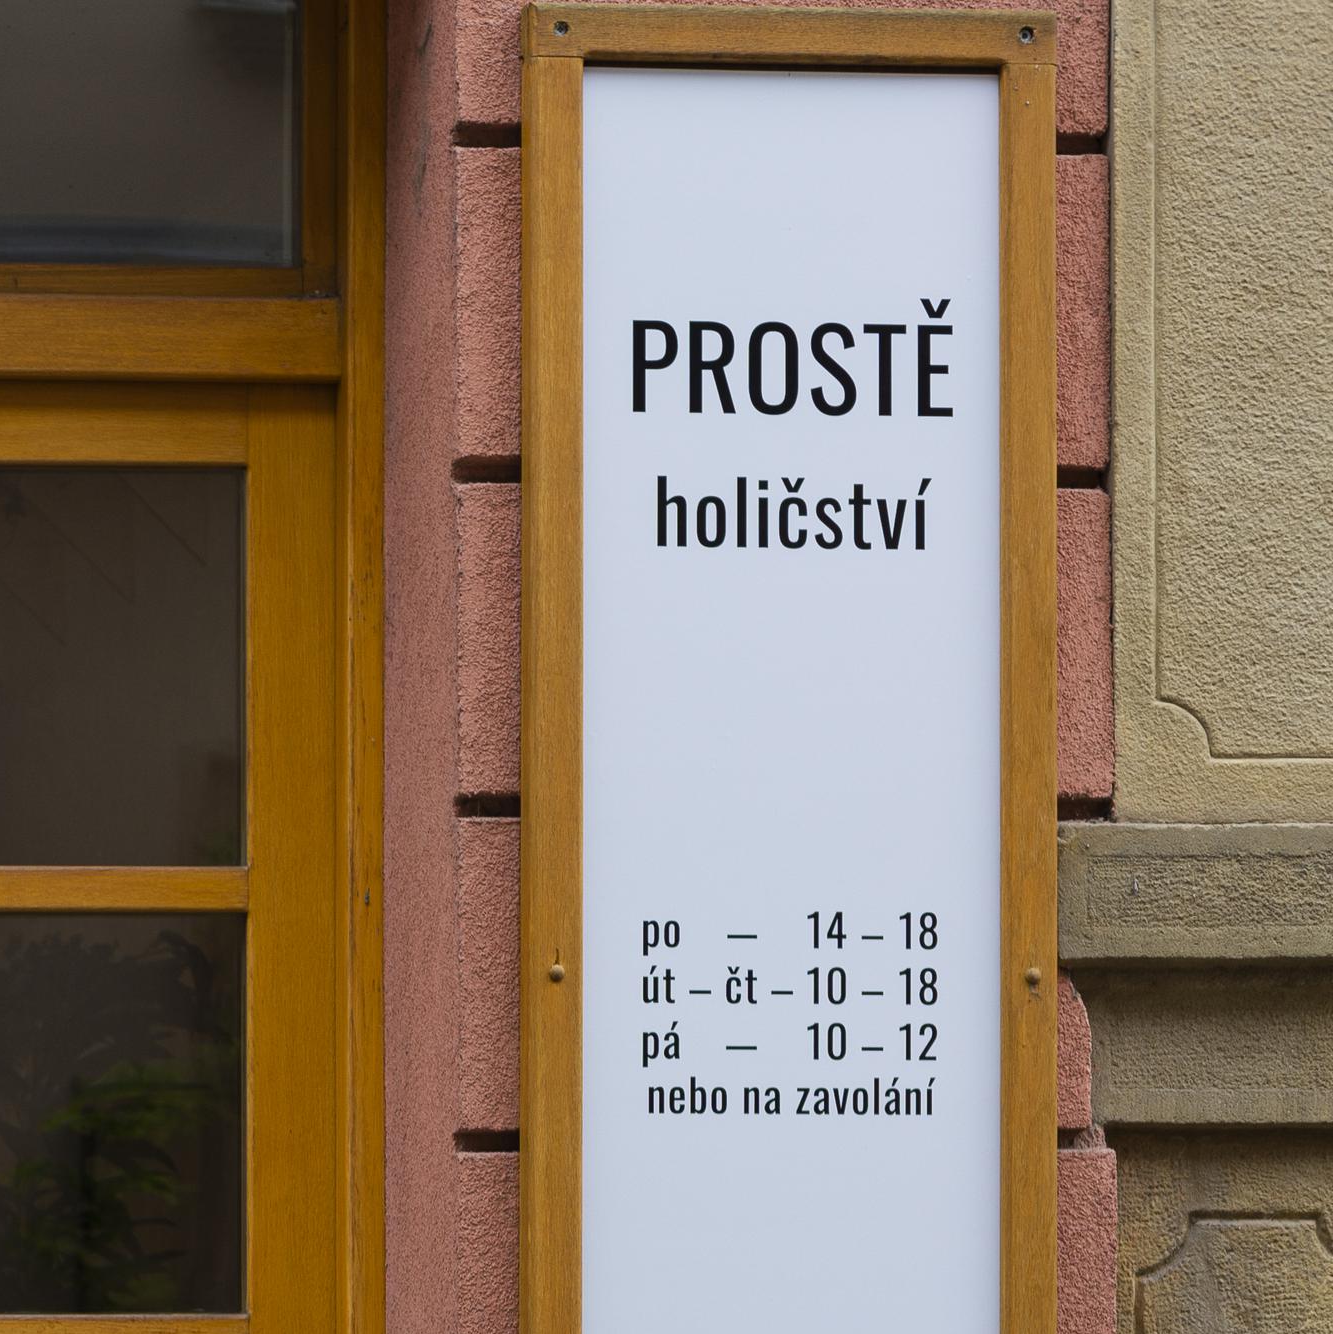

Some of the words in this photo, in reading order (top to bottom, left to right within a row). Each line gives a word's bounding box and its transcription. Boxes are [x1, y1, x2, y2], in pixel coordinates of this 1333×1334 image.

[632, 298, 954, 418] PROSTĚ
[656, 475, 932, 551] holičství
[642, 920, 681, 957] po
[806, 911, 847, 950] 14
[899, 911, 938, 951] 18
[642, 964, 676, 1004] út
[725, 965, 758, 1005] čt
[806, 966, 847, 1005] 10
[898, 967, 938, 1006] 18
[642, 1020, 681, 1068] pá
[806, 1022, 847, 1061] 10
[898, 1022, 938, 1061] 12
[648, 1075, 728, 1115] nebo
[743, 1086, 781, 1115] na
[795, 1076, 936, 1116] zavolání
